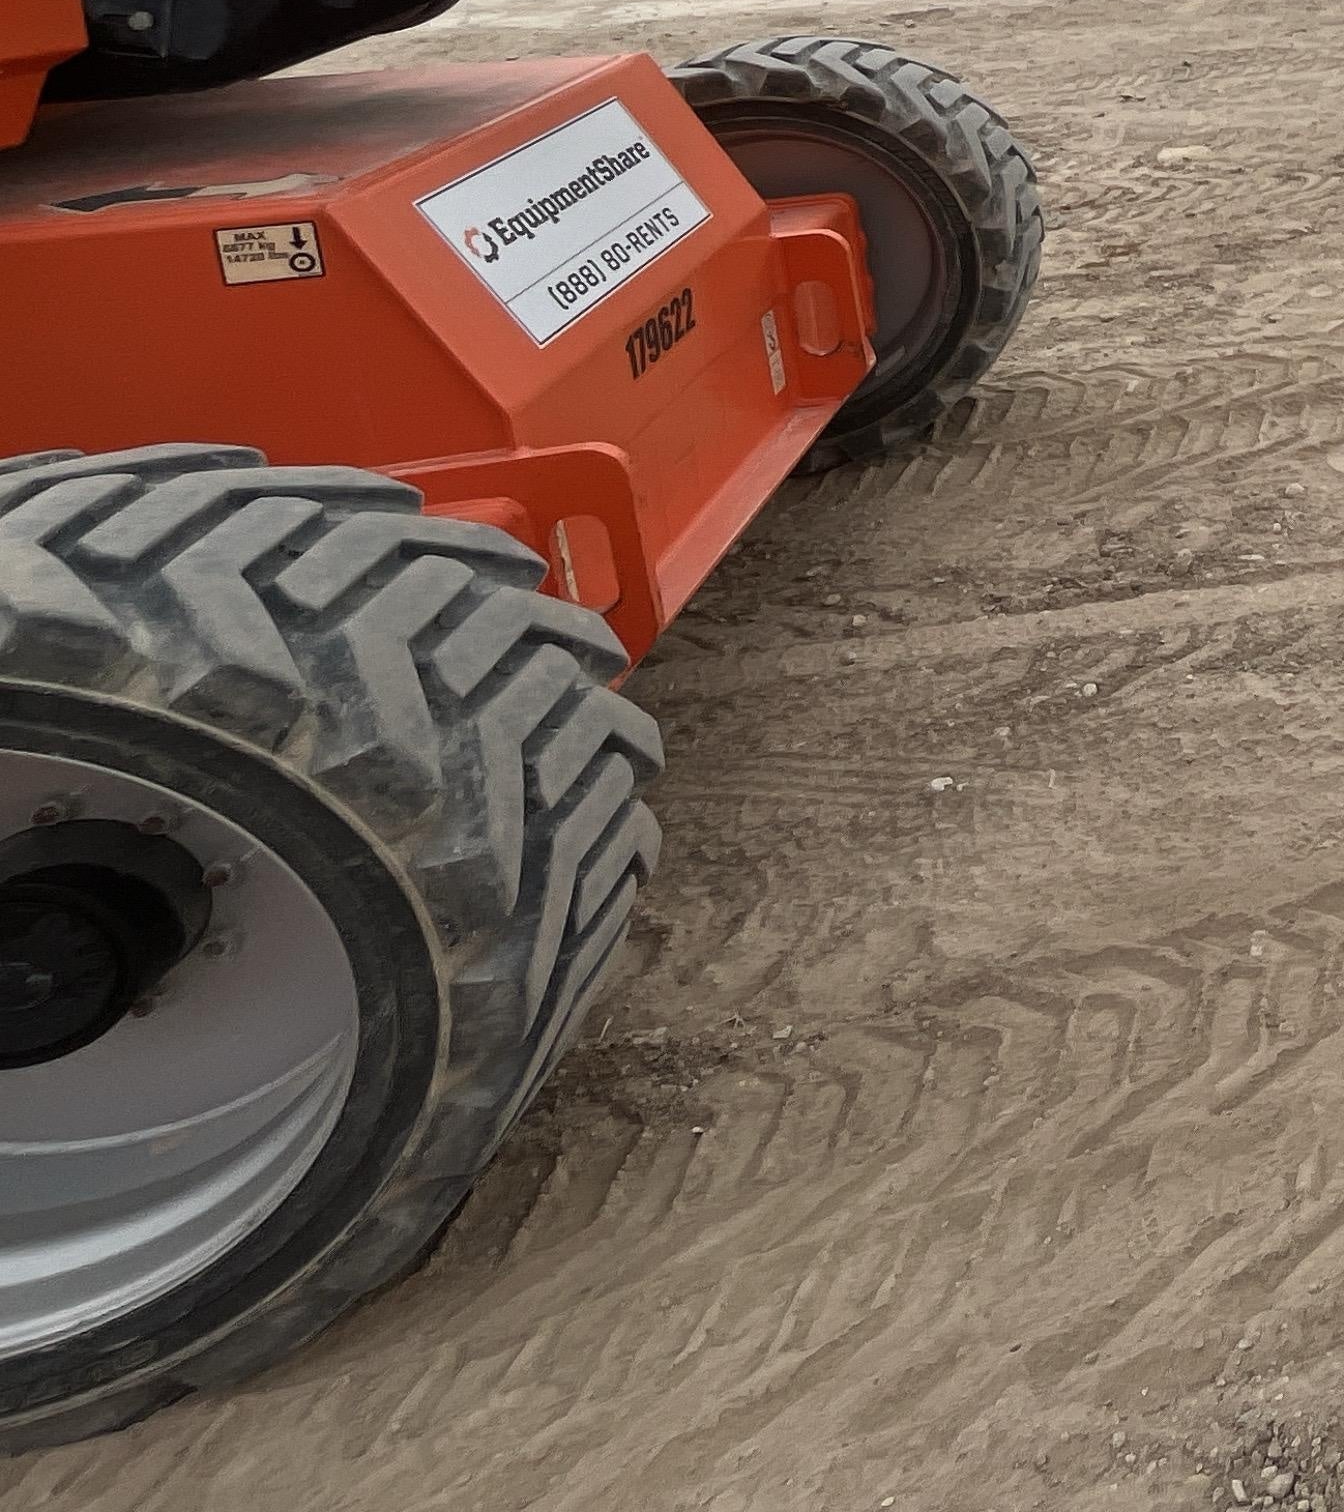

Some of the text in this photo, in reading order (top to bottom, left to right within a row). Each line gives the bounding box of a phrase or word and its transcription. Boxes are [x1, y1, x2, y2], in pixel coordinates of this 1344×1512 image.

[233, 231, 267, 242] MAX
[487, 141, 650, 247] EquipmentShare
[547, 206, 680, 310] (888) 80-RENTS
[624, 287, 697, 381] 179622
